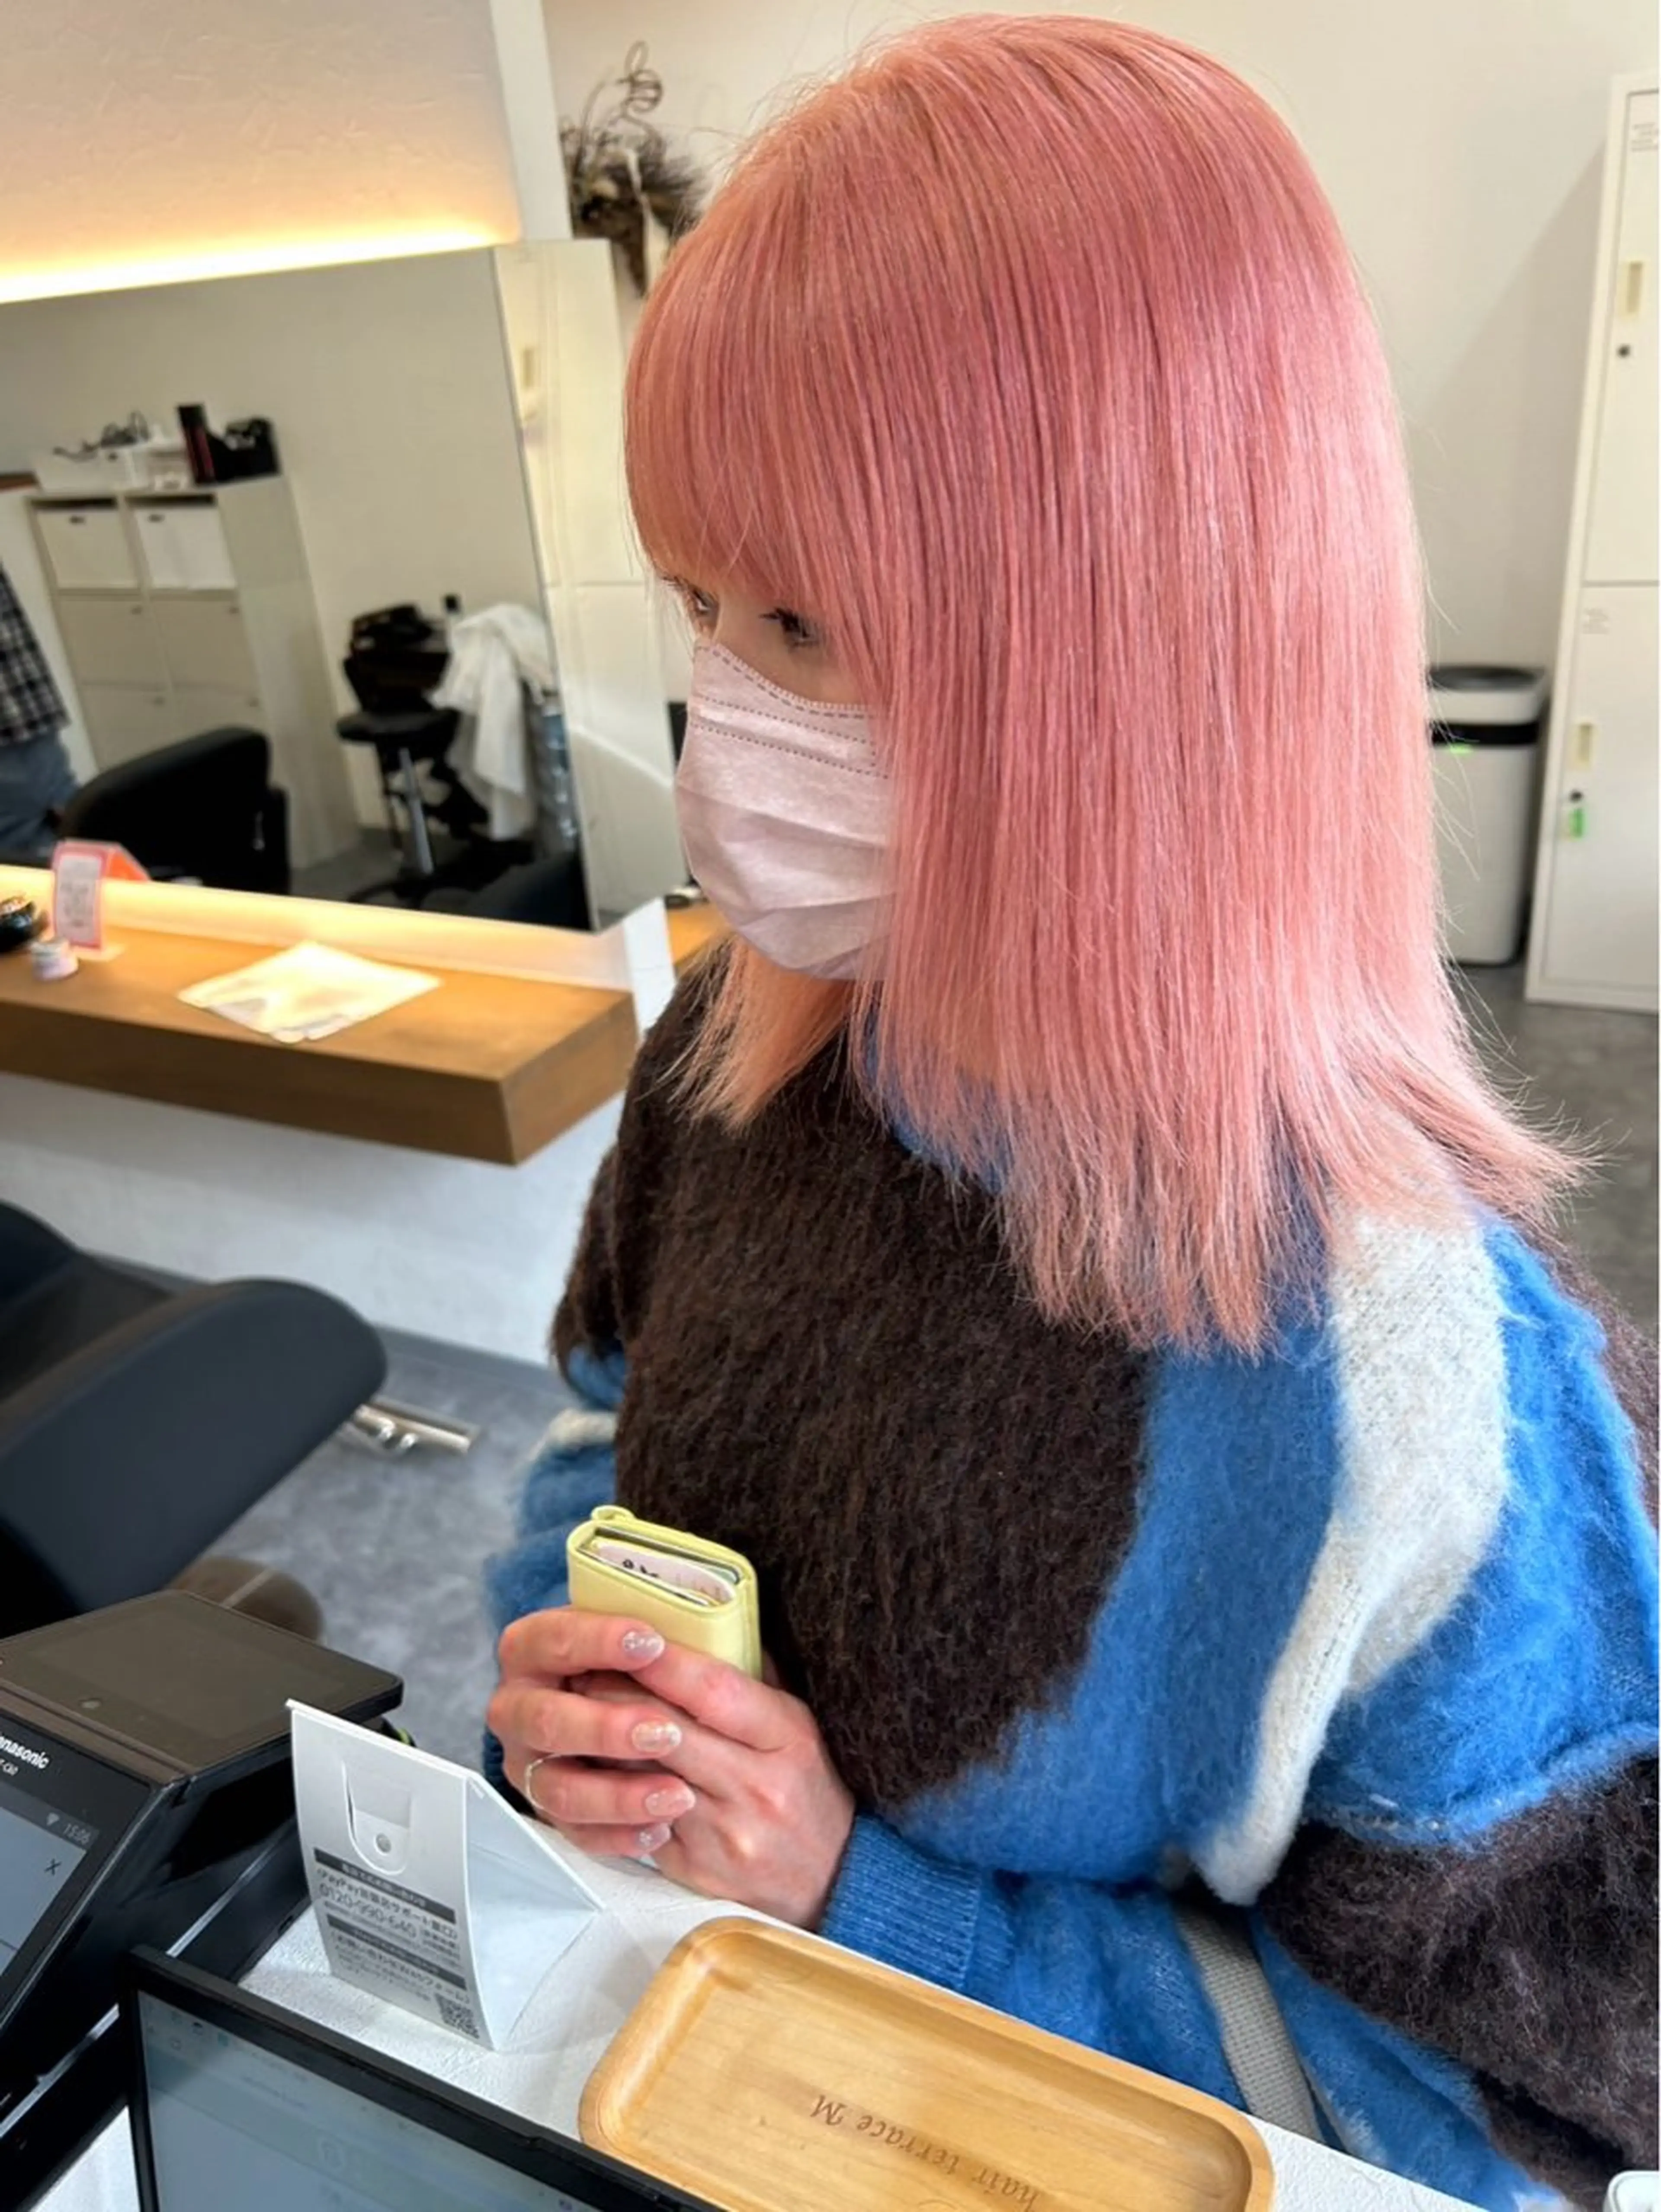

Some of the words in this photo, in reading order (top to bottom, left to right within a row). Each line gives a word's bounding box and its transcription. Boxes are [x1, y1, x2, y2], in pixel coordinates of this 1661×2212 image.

[0, 1736, 50, 1770] anasonic
[810, 2094, 847, 2126] M
[856, 2114, 959, 2175] terrace
[971, 2167, 1040, 2212] hair
